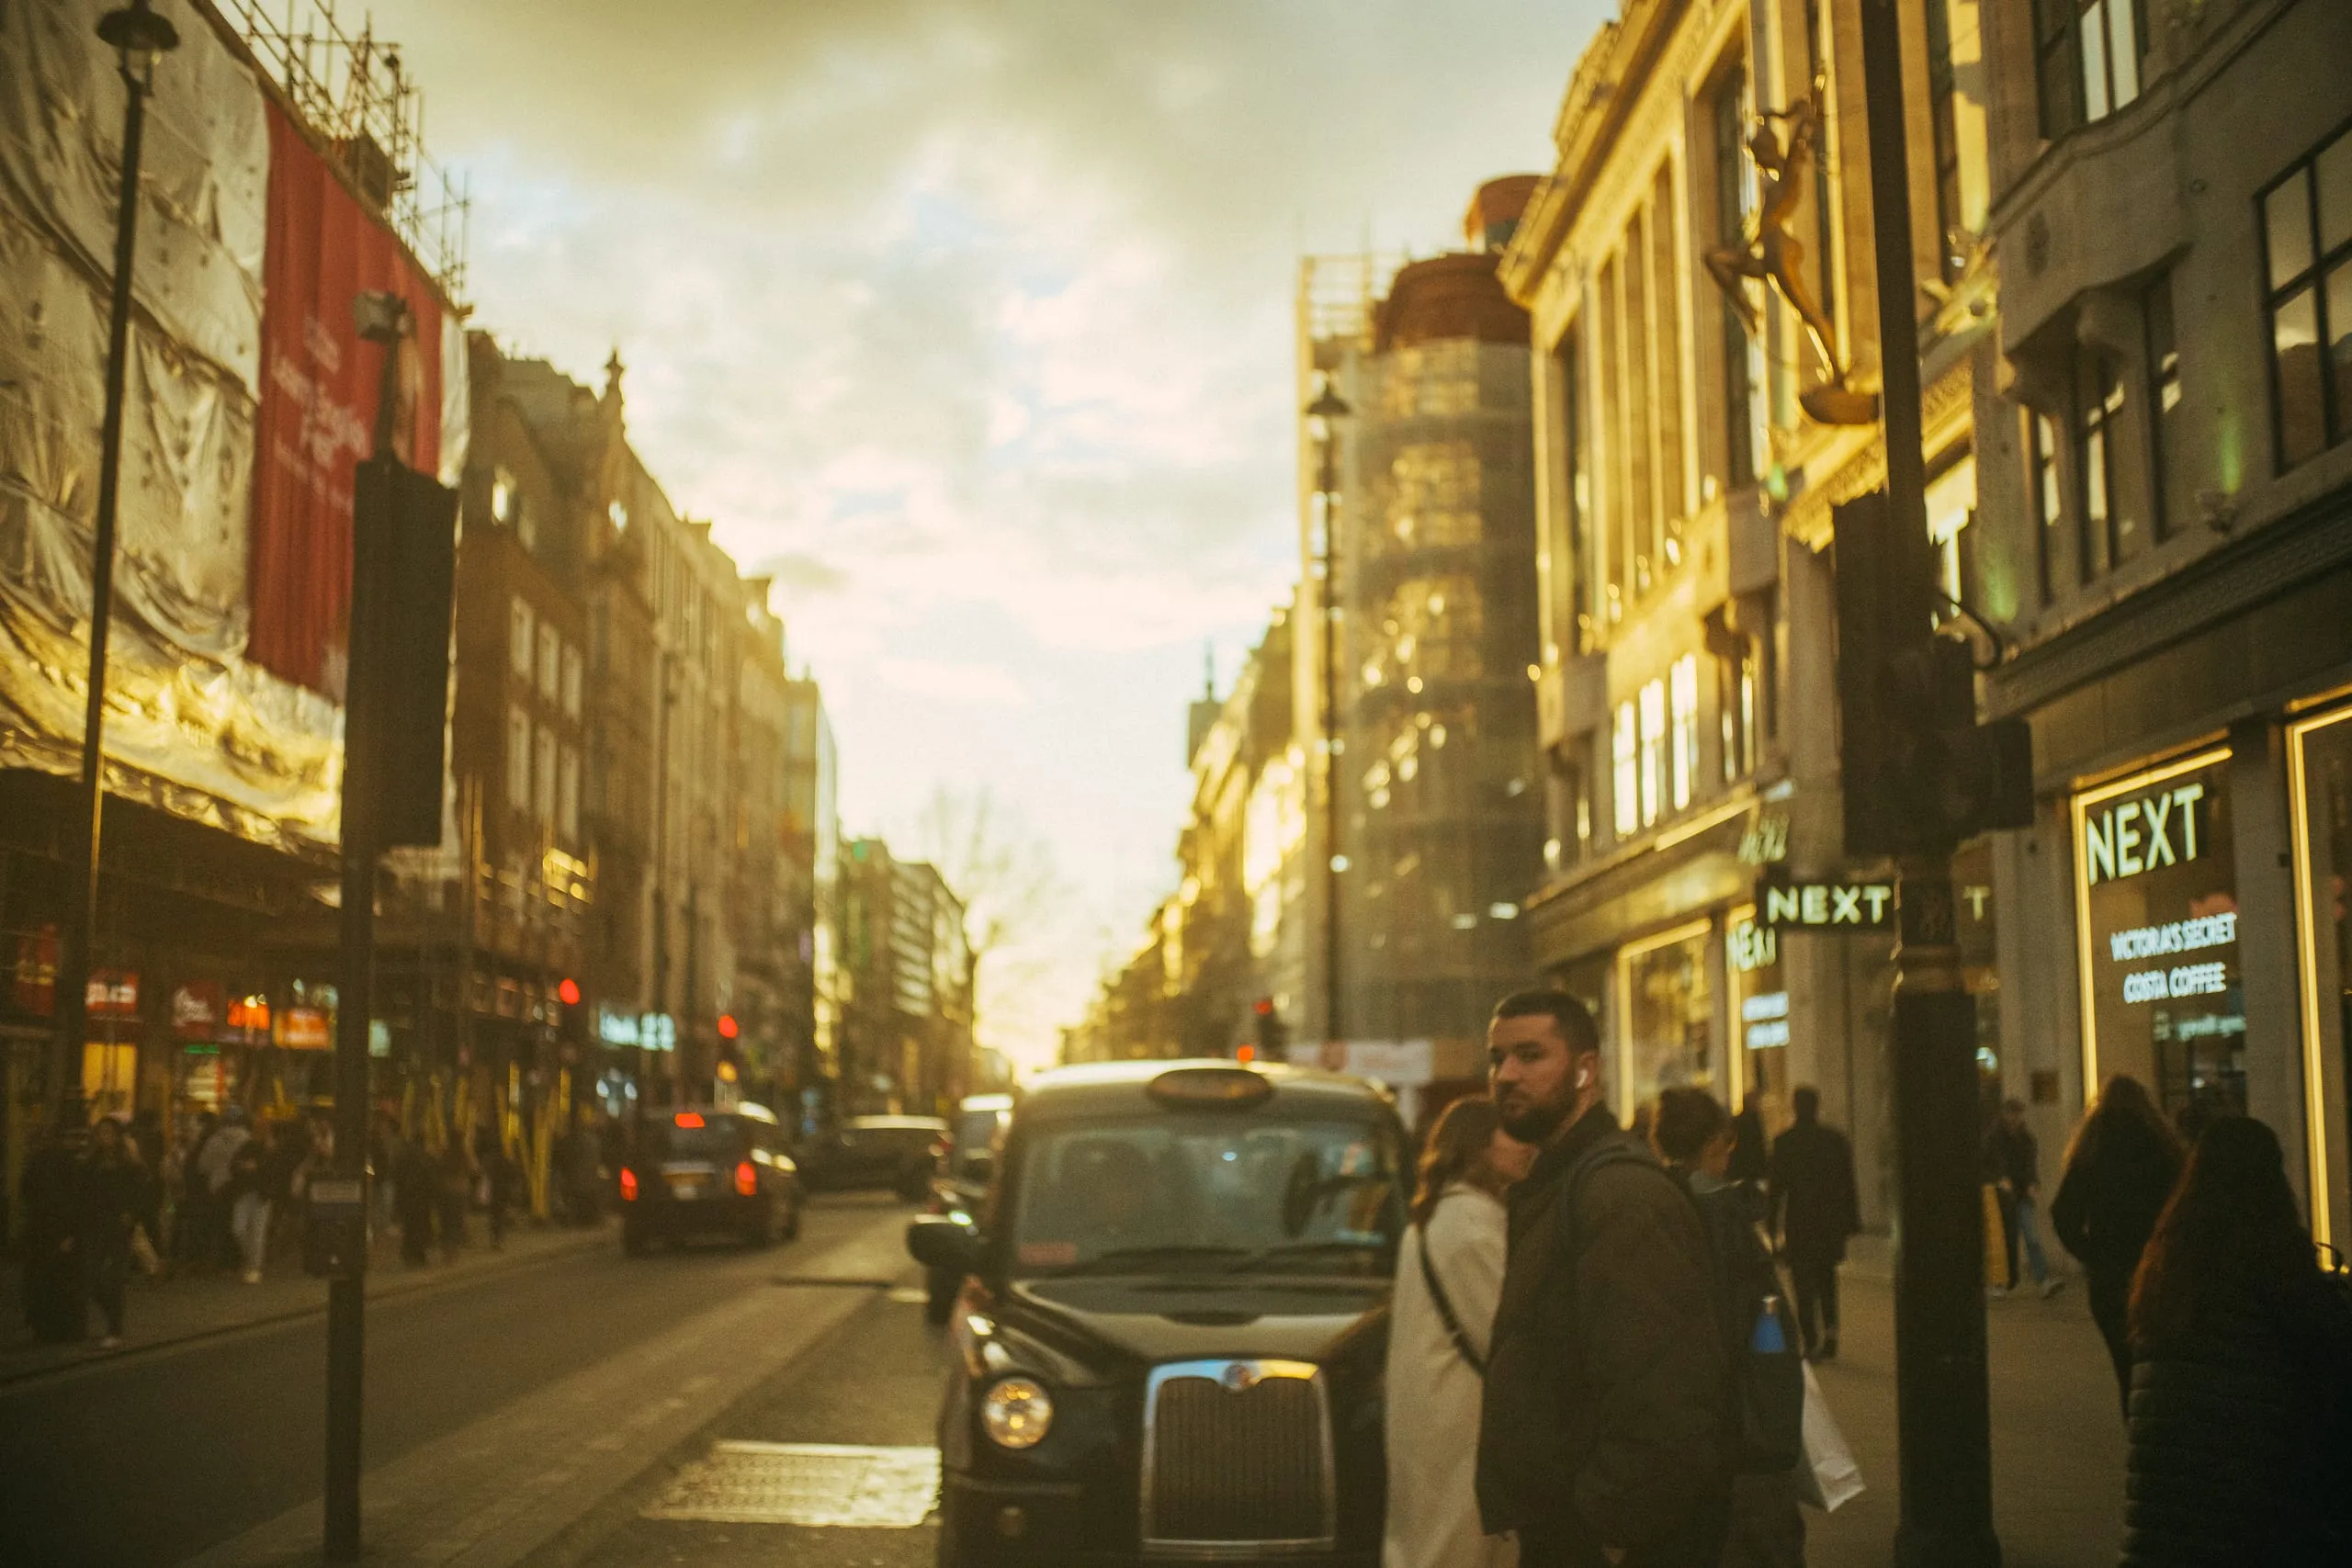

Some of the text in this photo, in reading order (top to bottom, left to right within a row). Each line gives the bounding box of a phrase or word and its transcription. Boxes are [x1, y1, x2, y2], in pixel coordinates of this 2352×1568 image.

[2086, 783, 2204, 886] NEXT
[1766, 885, 1892, 924] NEXT
[2182, 911, 2237, 951] SECRET
[2123, 962, 2226, 1004] COSTA COFFEE
